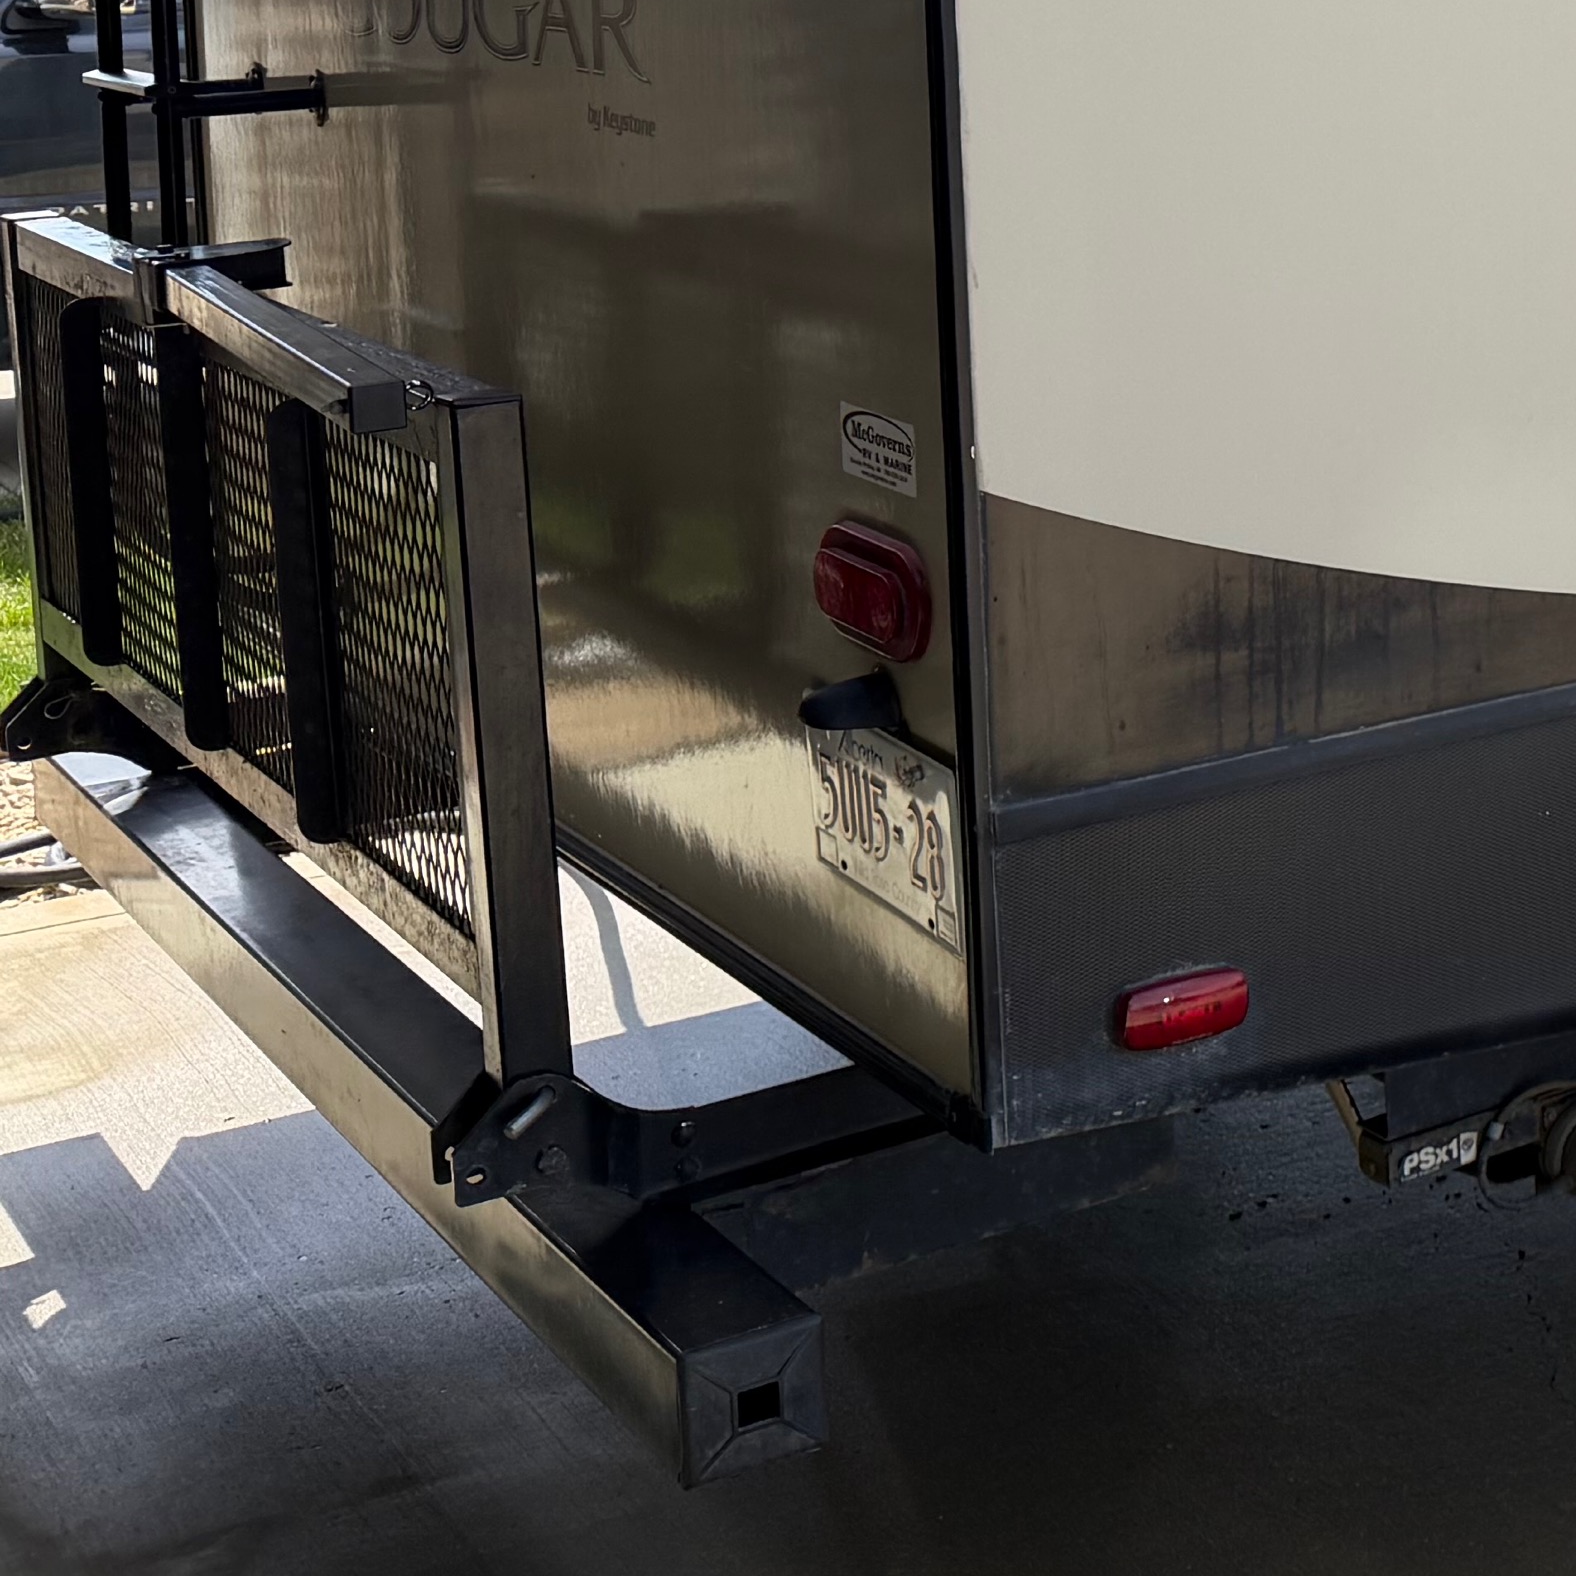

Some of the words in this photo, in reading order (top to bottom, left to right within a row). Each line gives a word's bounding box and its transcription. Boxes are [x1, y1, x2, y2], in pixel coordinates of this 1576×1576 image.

[587, 102, 601, 131] by
[603, 105, 656, 137] Keystone
[851, 418, 912, 458] McGoverns
